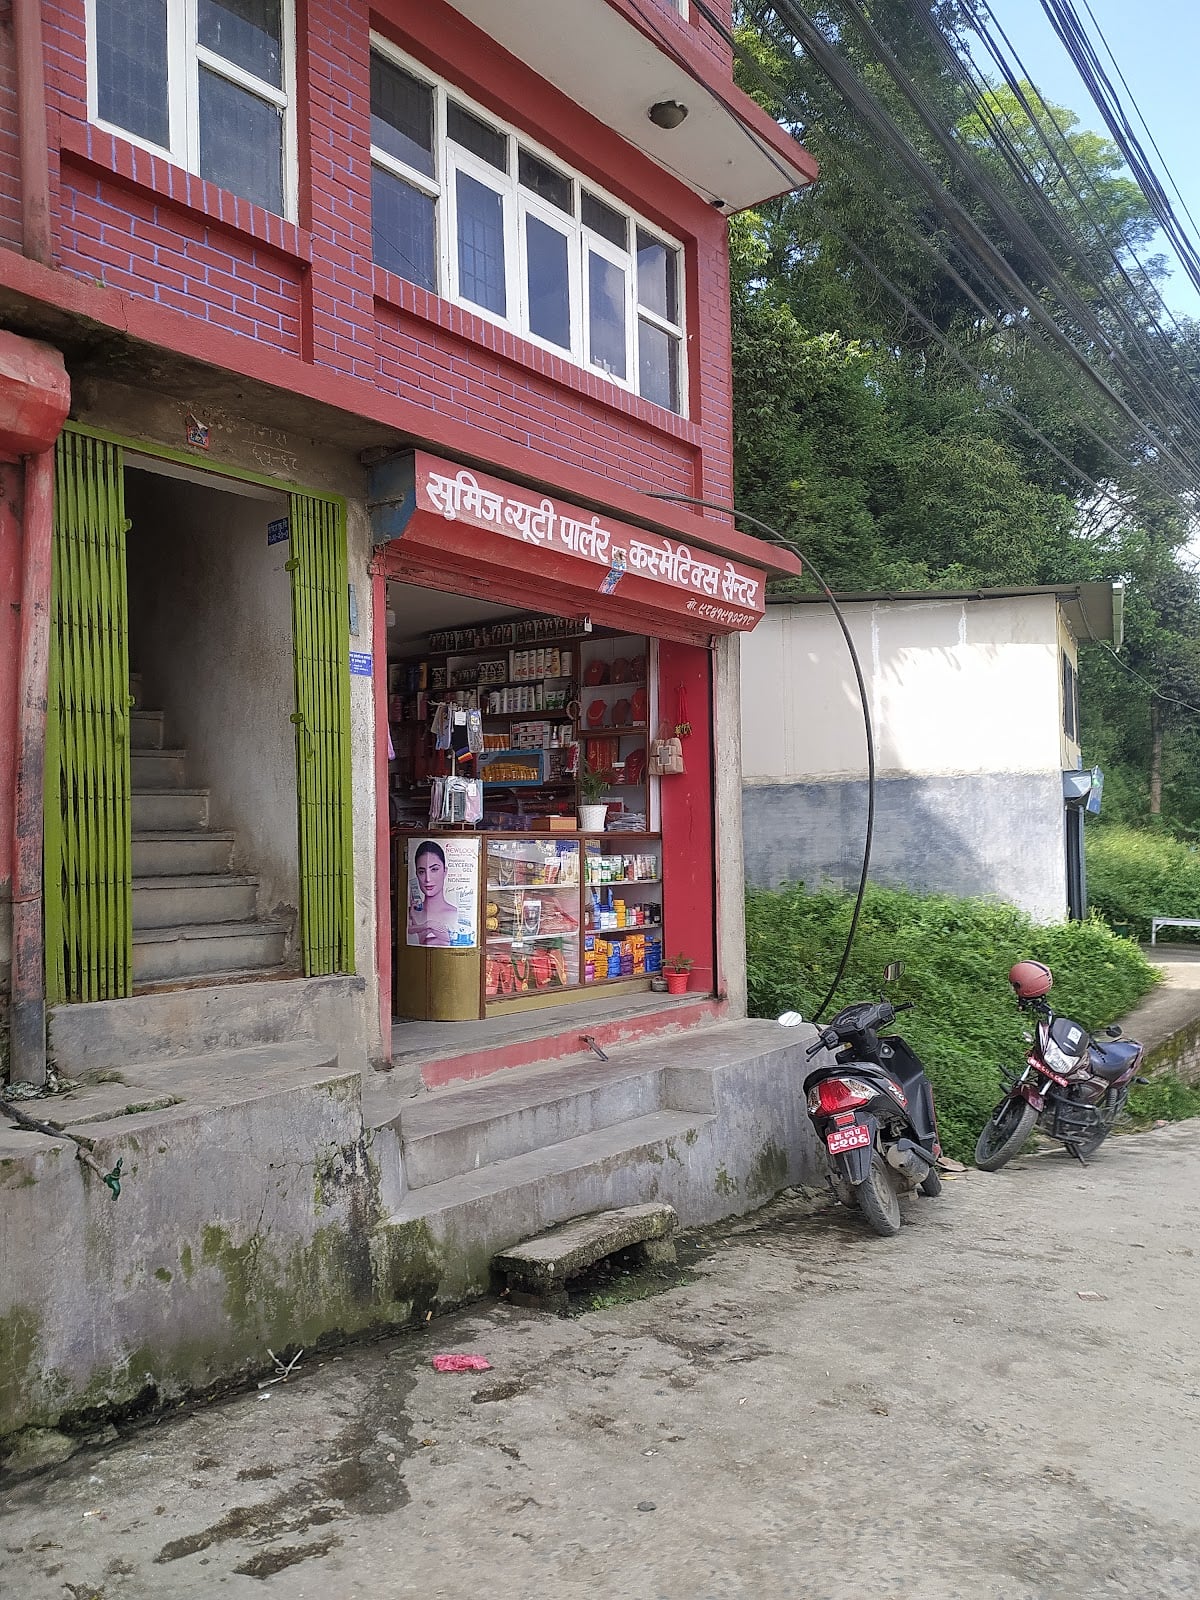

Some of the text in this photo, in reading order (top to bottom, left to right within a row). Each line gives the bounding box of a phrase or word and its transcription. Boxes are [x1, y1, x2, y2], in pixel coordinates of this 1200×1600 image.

[426, 470, 503, 521] सुमिज
[560, 516, 611, 564] पार्लर
[629, 540, 720, 595] कस्मेटिक्स
[722, 562, 758, 607] सेन्टर
